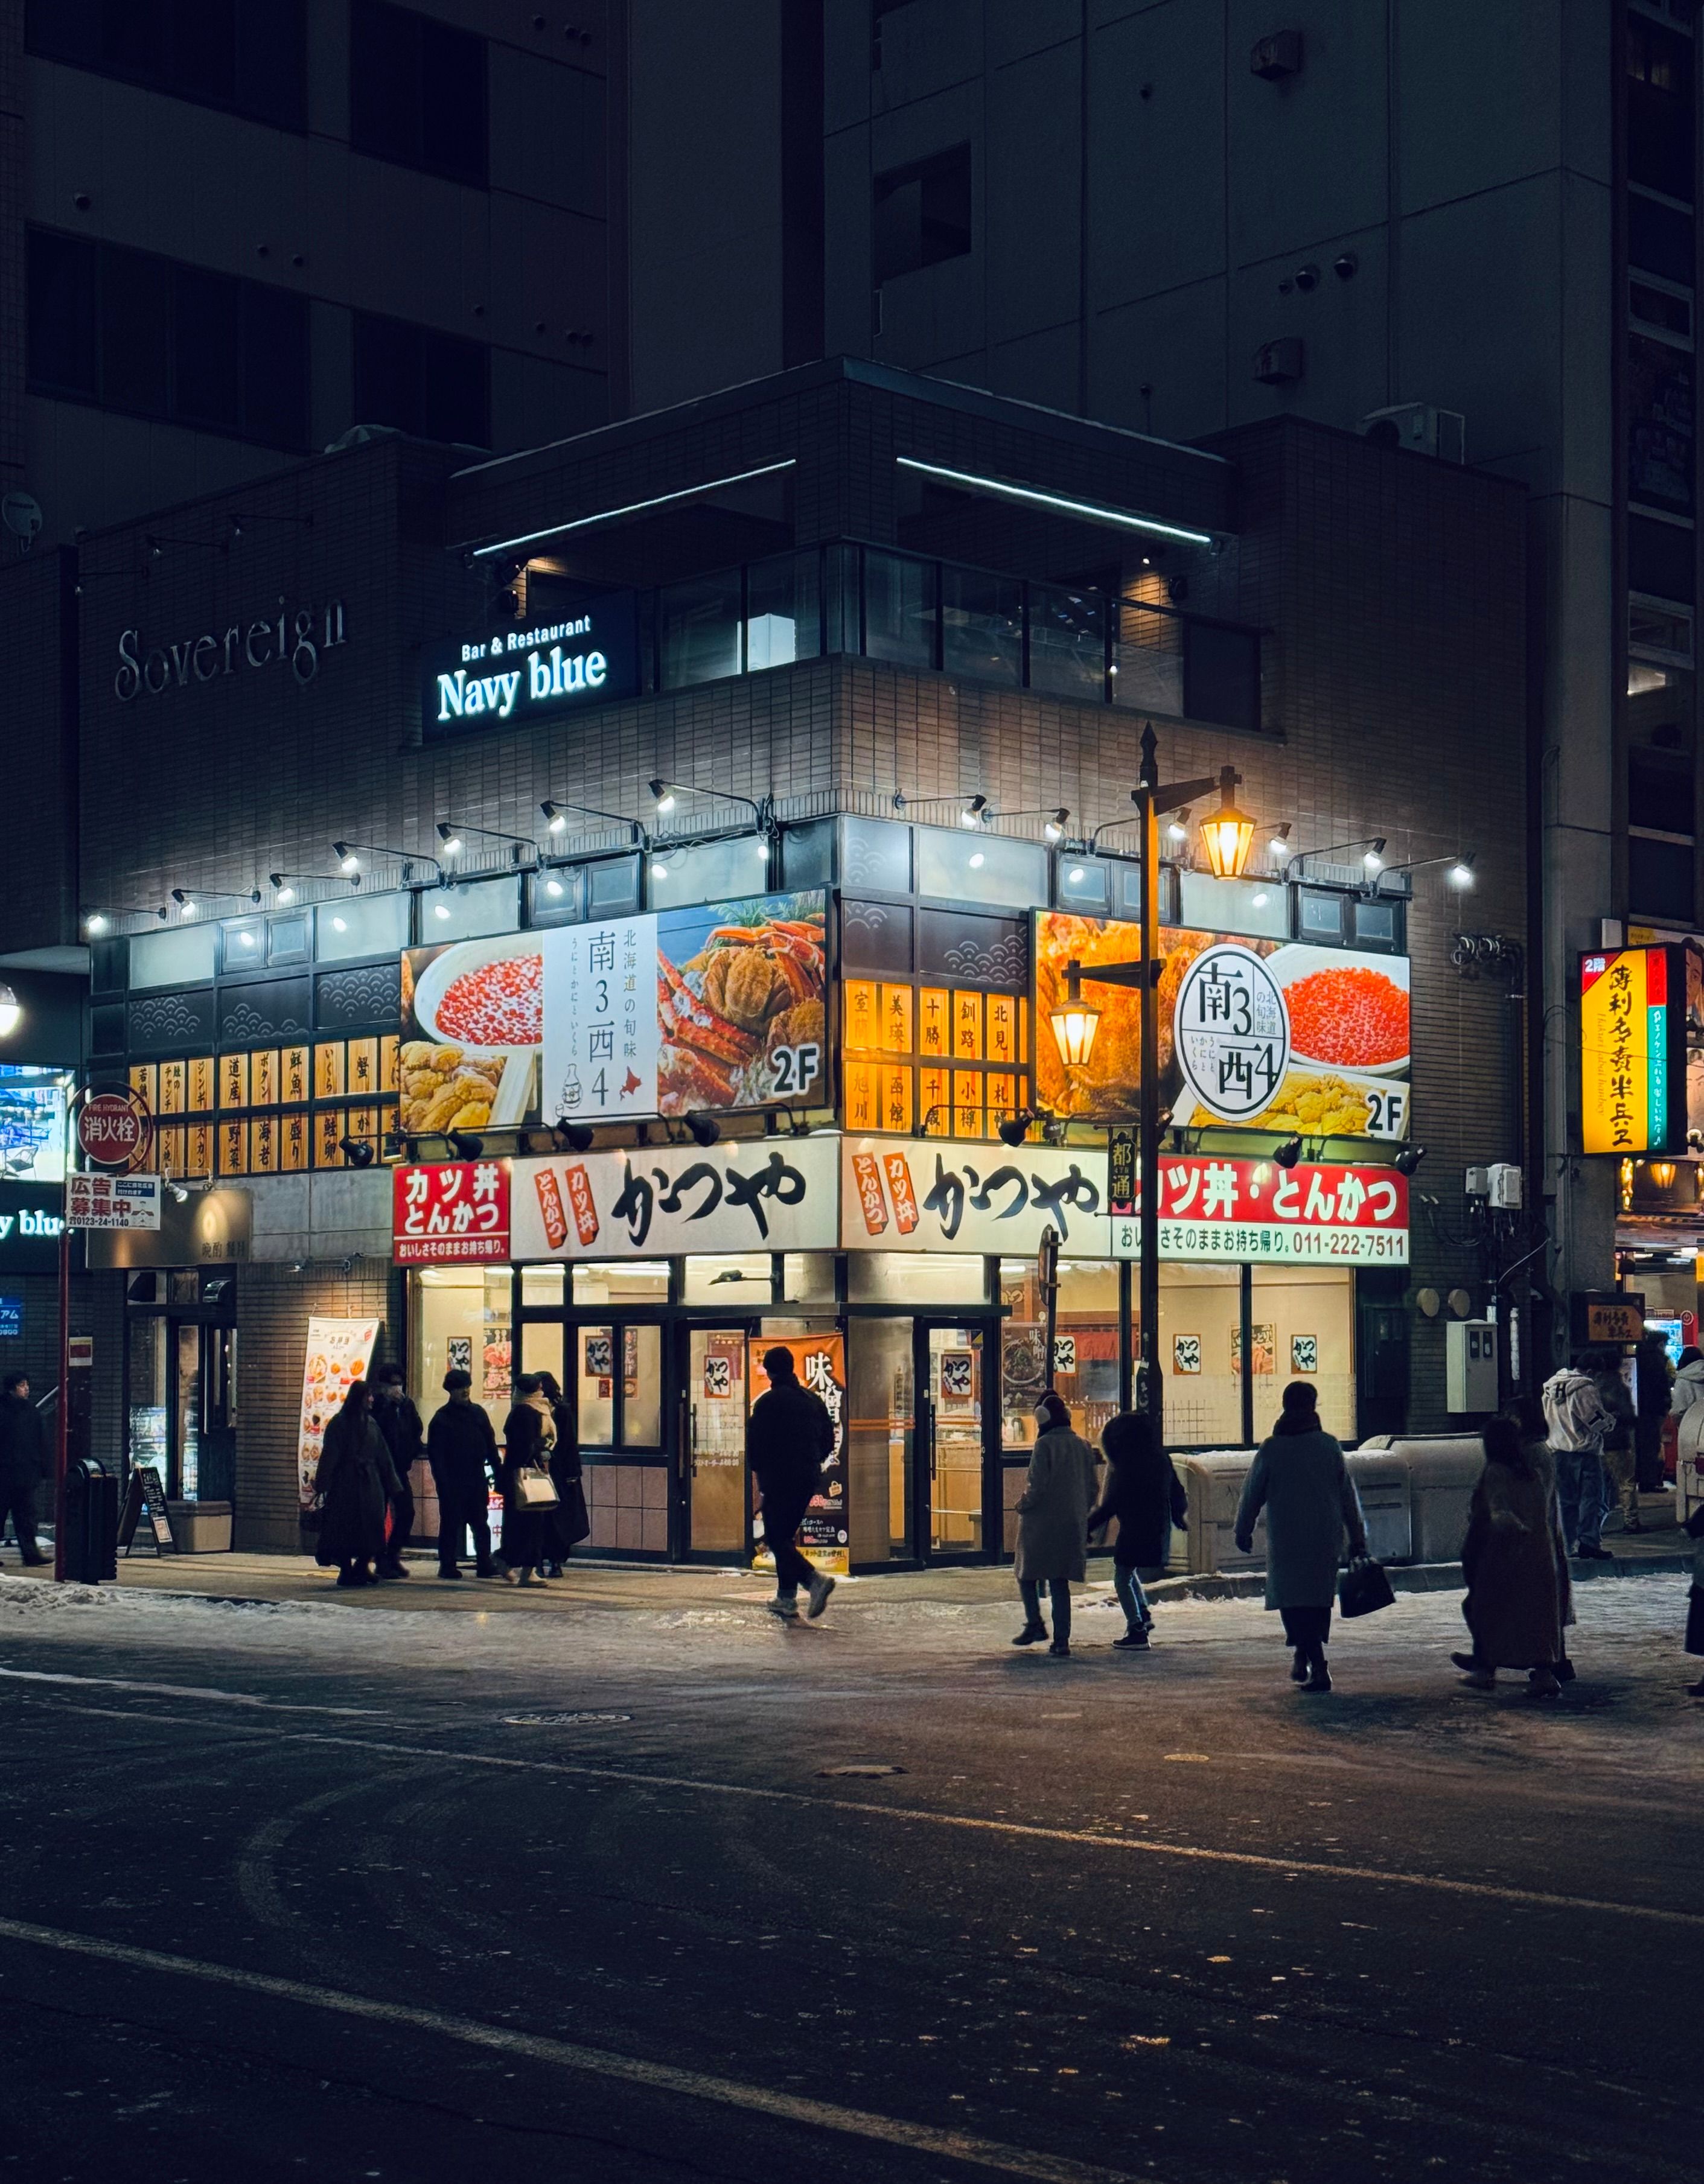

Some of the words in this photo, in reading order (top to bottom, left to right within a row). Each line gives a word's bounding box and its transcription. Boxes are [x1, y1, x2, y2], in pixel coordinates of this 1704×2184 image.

[115, 596, 347, 701] Sovereign
[462, 644, 485, 661] Bar
[491, 637, 503, 655] &
[508, 615, 590, 651] Restaurant
[438, 669, 520, 721] Navy
[528, 646, 607, 700] blue
[624, 929, 637, 1057] 北海道の旬味
[588, 931, 616, 1106] 南3西4
[925, 999, 940, 1045] 十勝
[960, 1001, 975, 1048] 釧路
[994, 1005, 1008, 1051] 北見
[773, 1049, 817, 1092] 2F
[85, 1116, 135, 1142] 消火栓
[1368, 1095, 1402, 1131] 2F
[71, 1176, 111, 1197] 広告
[405, 1163, 499, 1204] カツ丼
[611, 1151, 806, 1247] かつや
[855, 1157, 883, 1224] とんかつ
[923, 1153, 1100, 1242] かつや
[71, 1197, 131, 1218] 募集中
[404, 1200, 499, 1234] とんかつ
